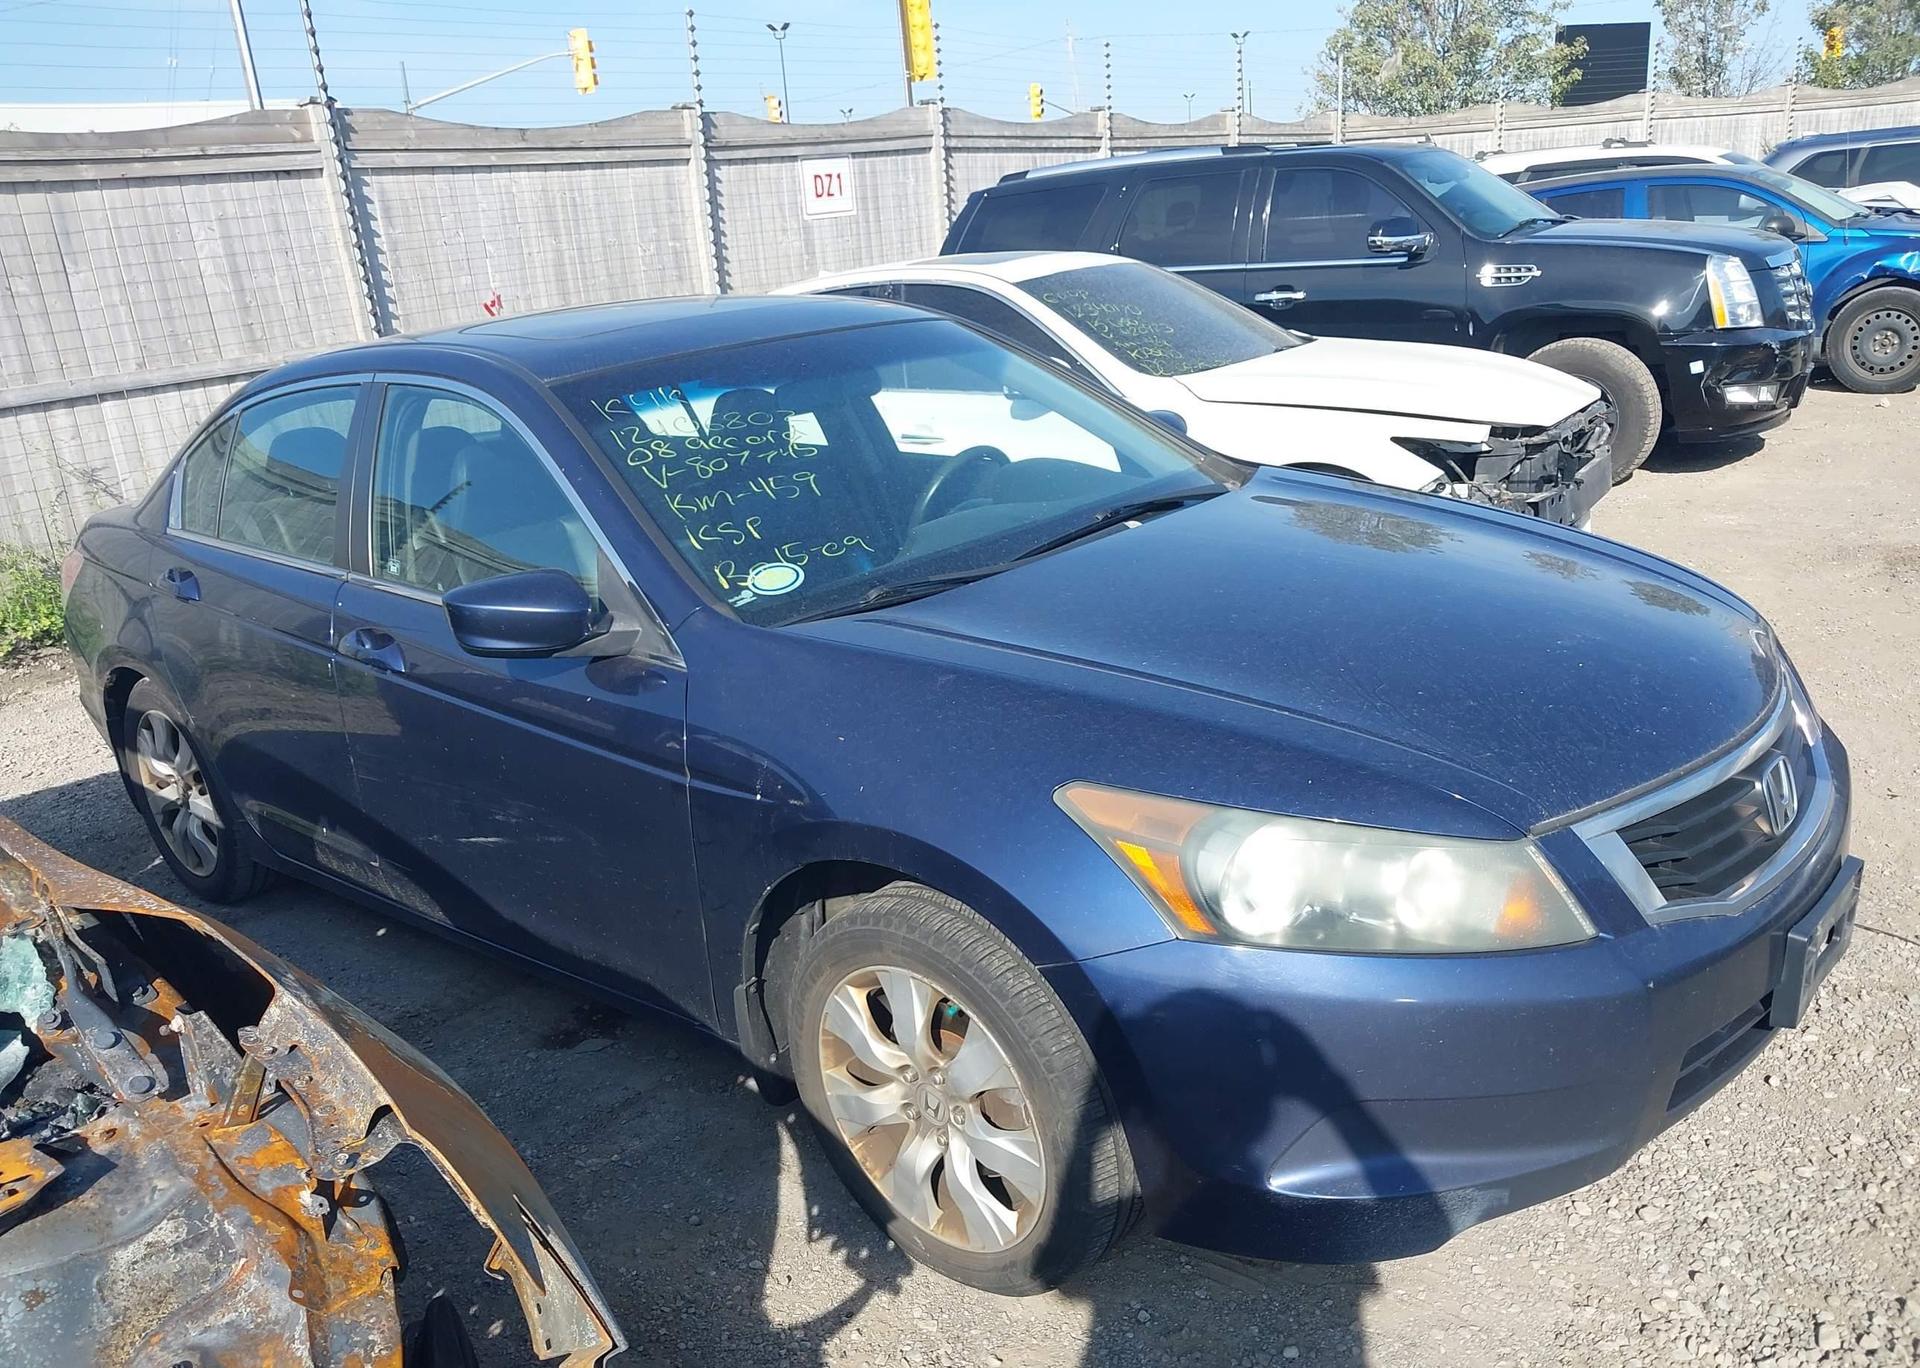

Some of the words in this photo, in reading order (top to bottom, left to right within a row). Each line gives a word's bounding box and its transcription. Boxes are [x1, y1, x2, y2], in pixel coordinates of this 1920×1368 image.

[813, 172, 843, 198] DZ1
[626, 438, 677, 466] 08
[684, 516, 762, 550] KSP
